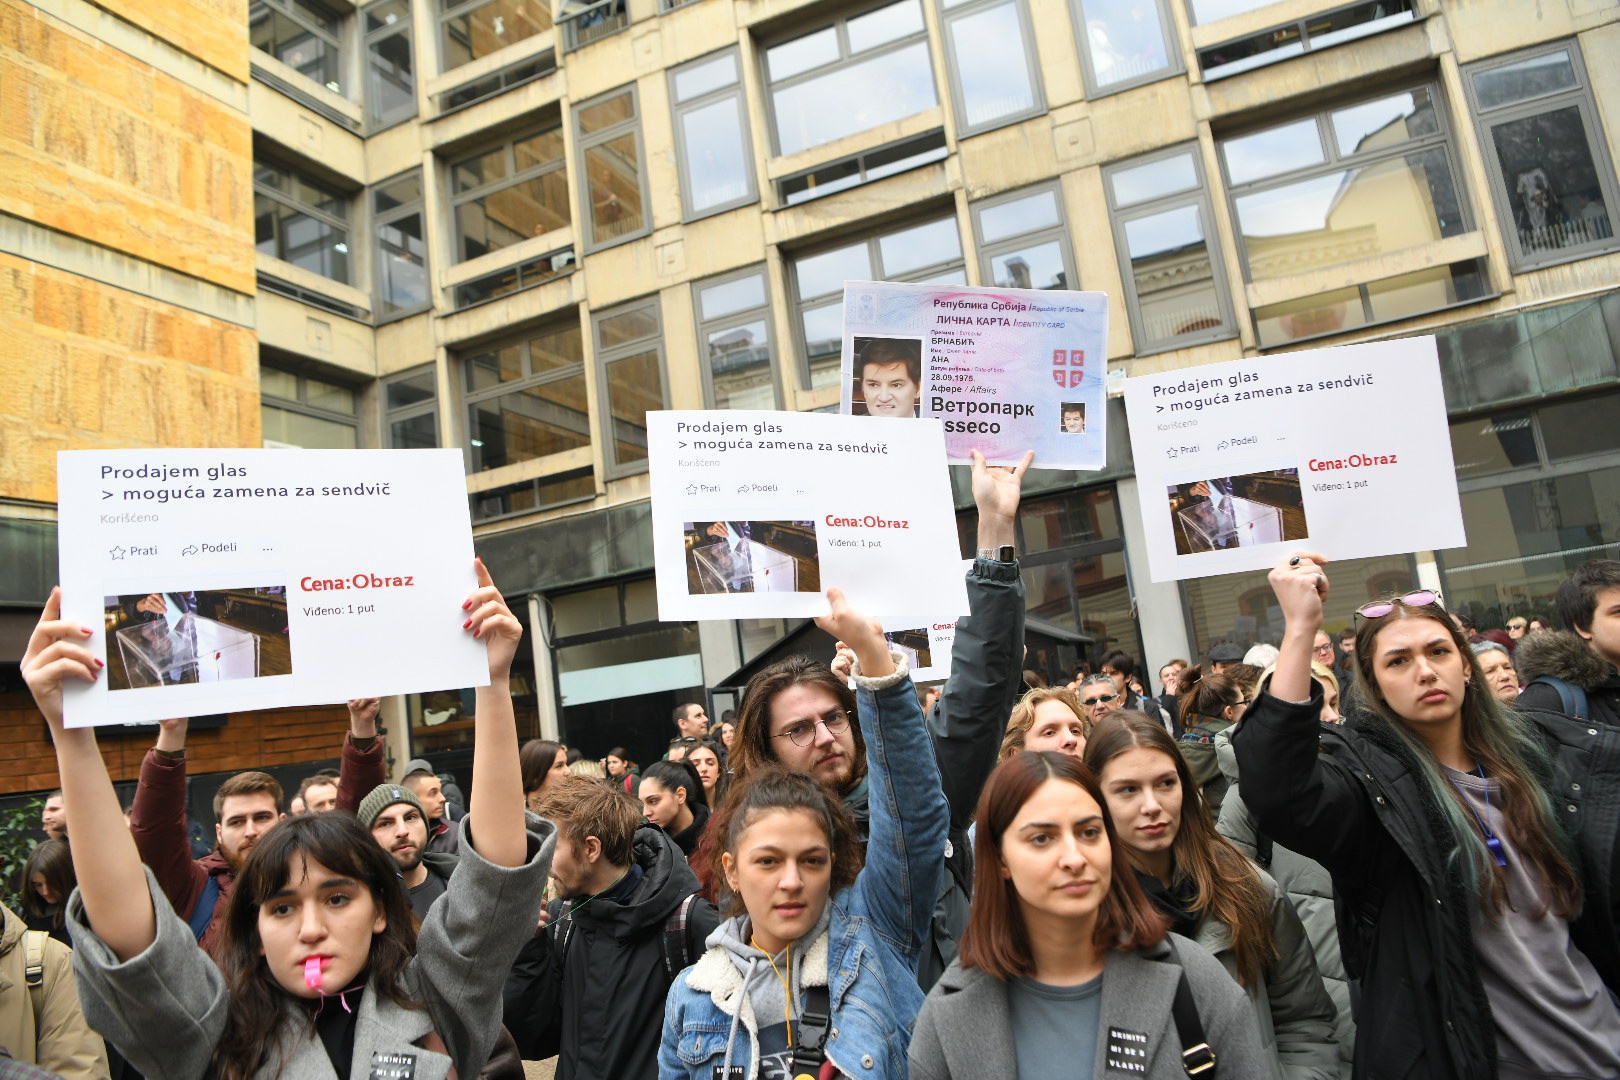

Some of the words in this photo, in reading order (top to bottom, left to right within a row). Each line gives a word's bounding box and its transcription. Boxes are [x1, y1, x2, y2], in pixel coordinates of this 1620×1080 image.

[934, 300, 988, 310] Република
[991, 302, 1027, 313] Србија
[937, 316, 973, 326] ЛИЧНА
[977, 317, 1011, 327] КАРТА
[931, 338, 975, 346] БРНАБИЋ
[931, 385, 962, 394] Афере
[970, 386, 997, 395] Affairs
[1153, 378, 1223, 398] Prodajem
[1229, 370, 1259, 391] glas
[1170, 392, 1230, 412] moguća
[1235, 385, 1293, 402] zamena
[1298, 382, 1314, 393] za
[1319, 373, 1374, 390] sendvič
[931, 397, 1035, 419] Ветропарк
[677, 422, 748, 436] Prodajem
[753, 421, 783, 436] glas
[935, 417, 1001, 434] sseco
[694, 437, 753, 452] moguća
[758, 439, 813, 451] zamena
[818, 442, 833, 452] za
[838, 442, 888, 455] sendvič
[1180, 444, 1200, 455] Prati
[1231, 435, 1258, 447] Podeli
[1309, 453, 1397, 472] Cena:Obraz
[101, 464, 200, 482] Prodajem
[207, 463, 247, 482] glas
[701, 484, 721, 493] Prati
[752, 483, 778, 492] Podeli
[1346, 480, 1352, 489] 1
[1355, 479, 1368, 490] put
[123, 486, 206, 504] moguća
[213, 484, 289, 499] zamena
[295, 485, 315, 498] za
[322, 482, 391, 498] sendvič
[825, 515, 909, 530] Cena:Obraz
[130, 545, 158, 557] Prati
[202, 542, 237, 554] Podeli
[861, 539, 866, 547] 1
[868, 539, 882, 548] put
[300, 573, 414, 593] Cena:Obraz
[347, 605, 353, 615] 1
[357, 603, 376, 616] put
[1111, 1031, 1147, 1043] SKINITE
[1111, 1045, 1122, 1053] MI
